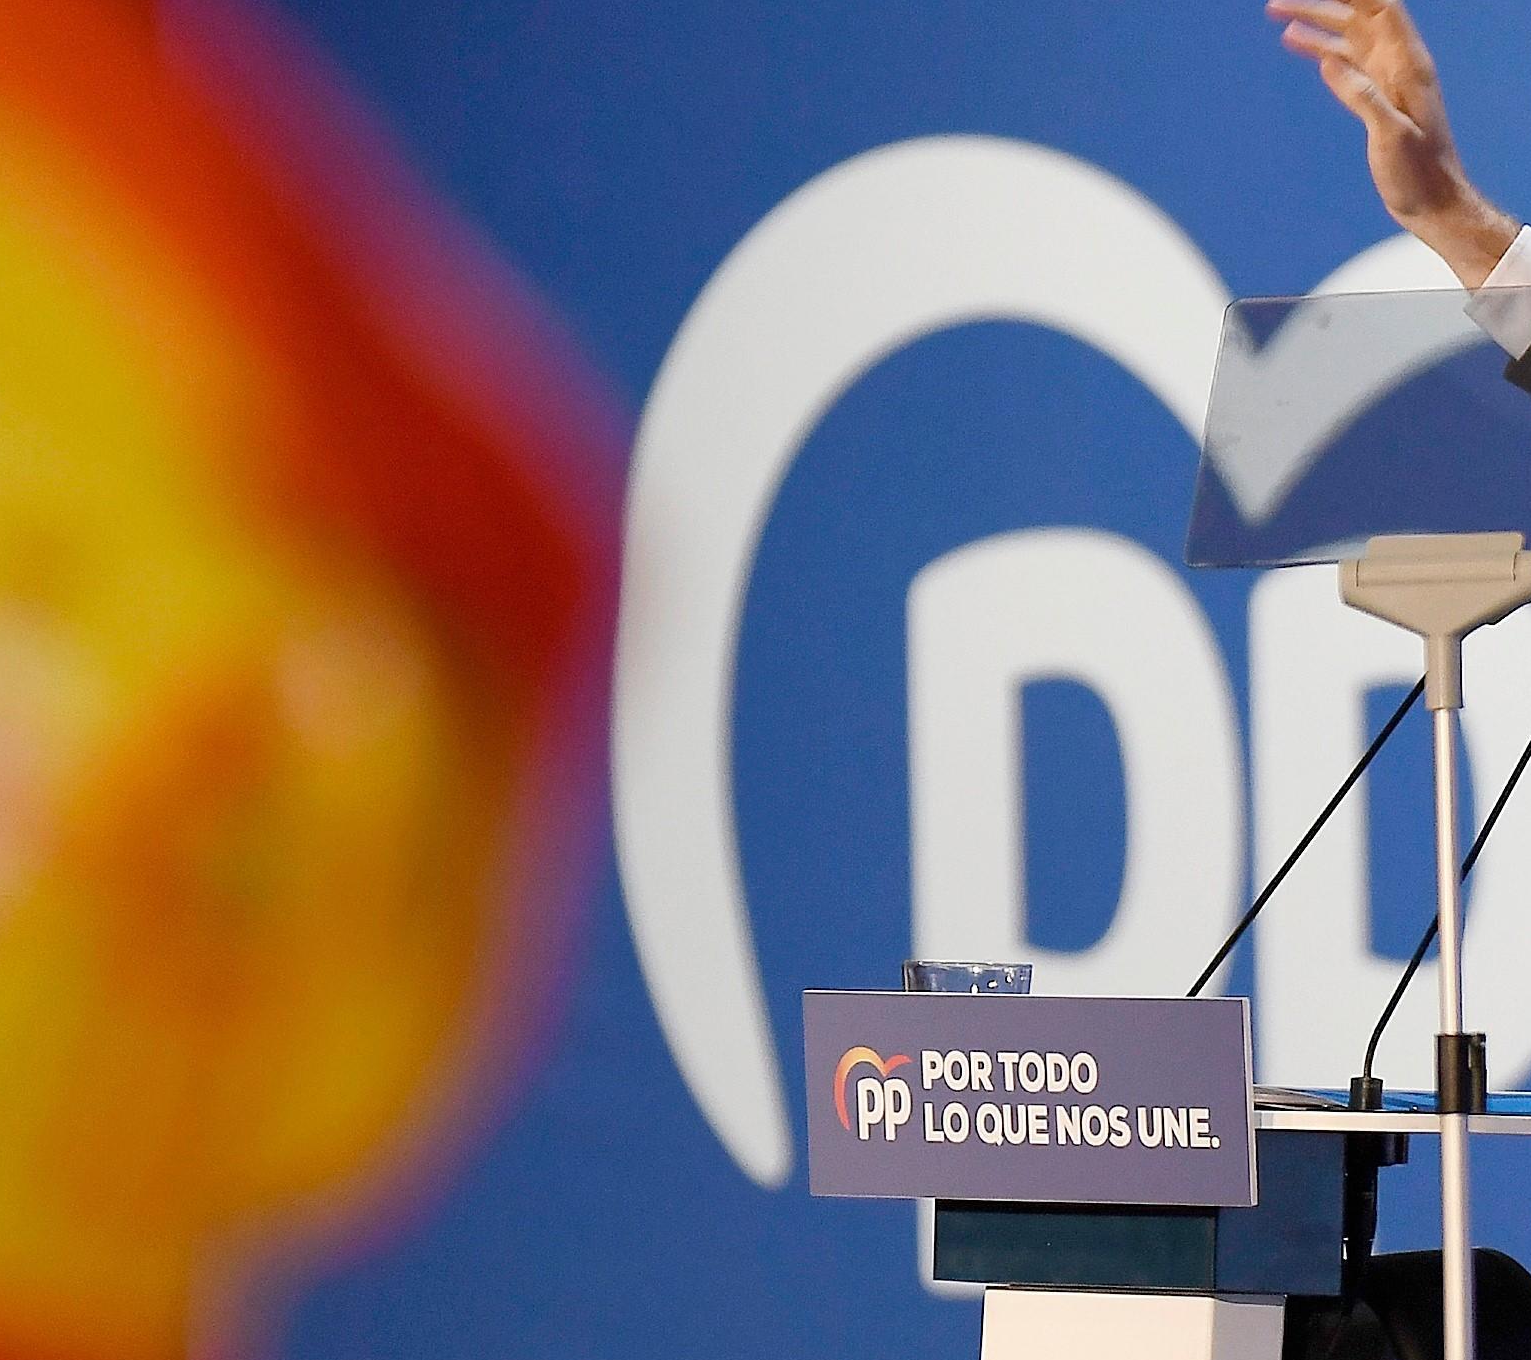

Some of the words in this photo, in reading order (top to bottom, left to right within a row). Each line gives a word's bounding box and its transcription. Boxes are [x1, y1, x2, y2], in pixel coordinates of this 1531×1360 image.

[921, 1049, 994, 1091] POR
[997, 1051, 1098, 1094] TODO
[923, 1101, 969, 1143] LO
[975, 1101, 1050, 1147] QUE
[1055, 1104, 1132, 1148] NOS
[1136, 1106, 1221, 1149] UNE.
